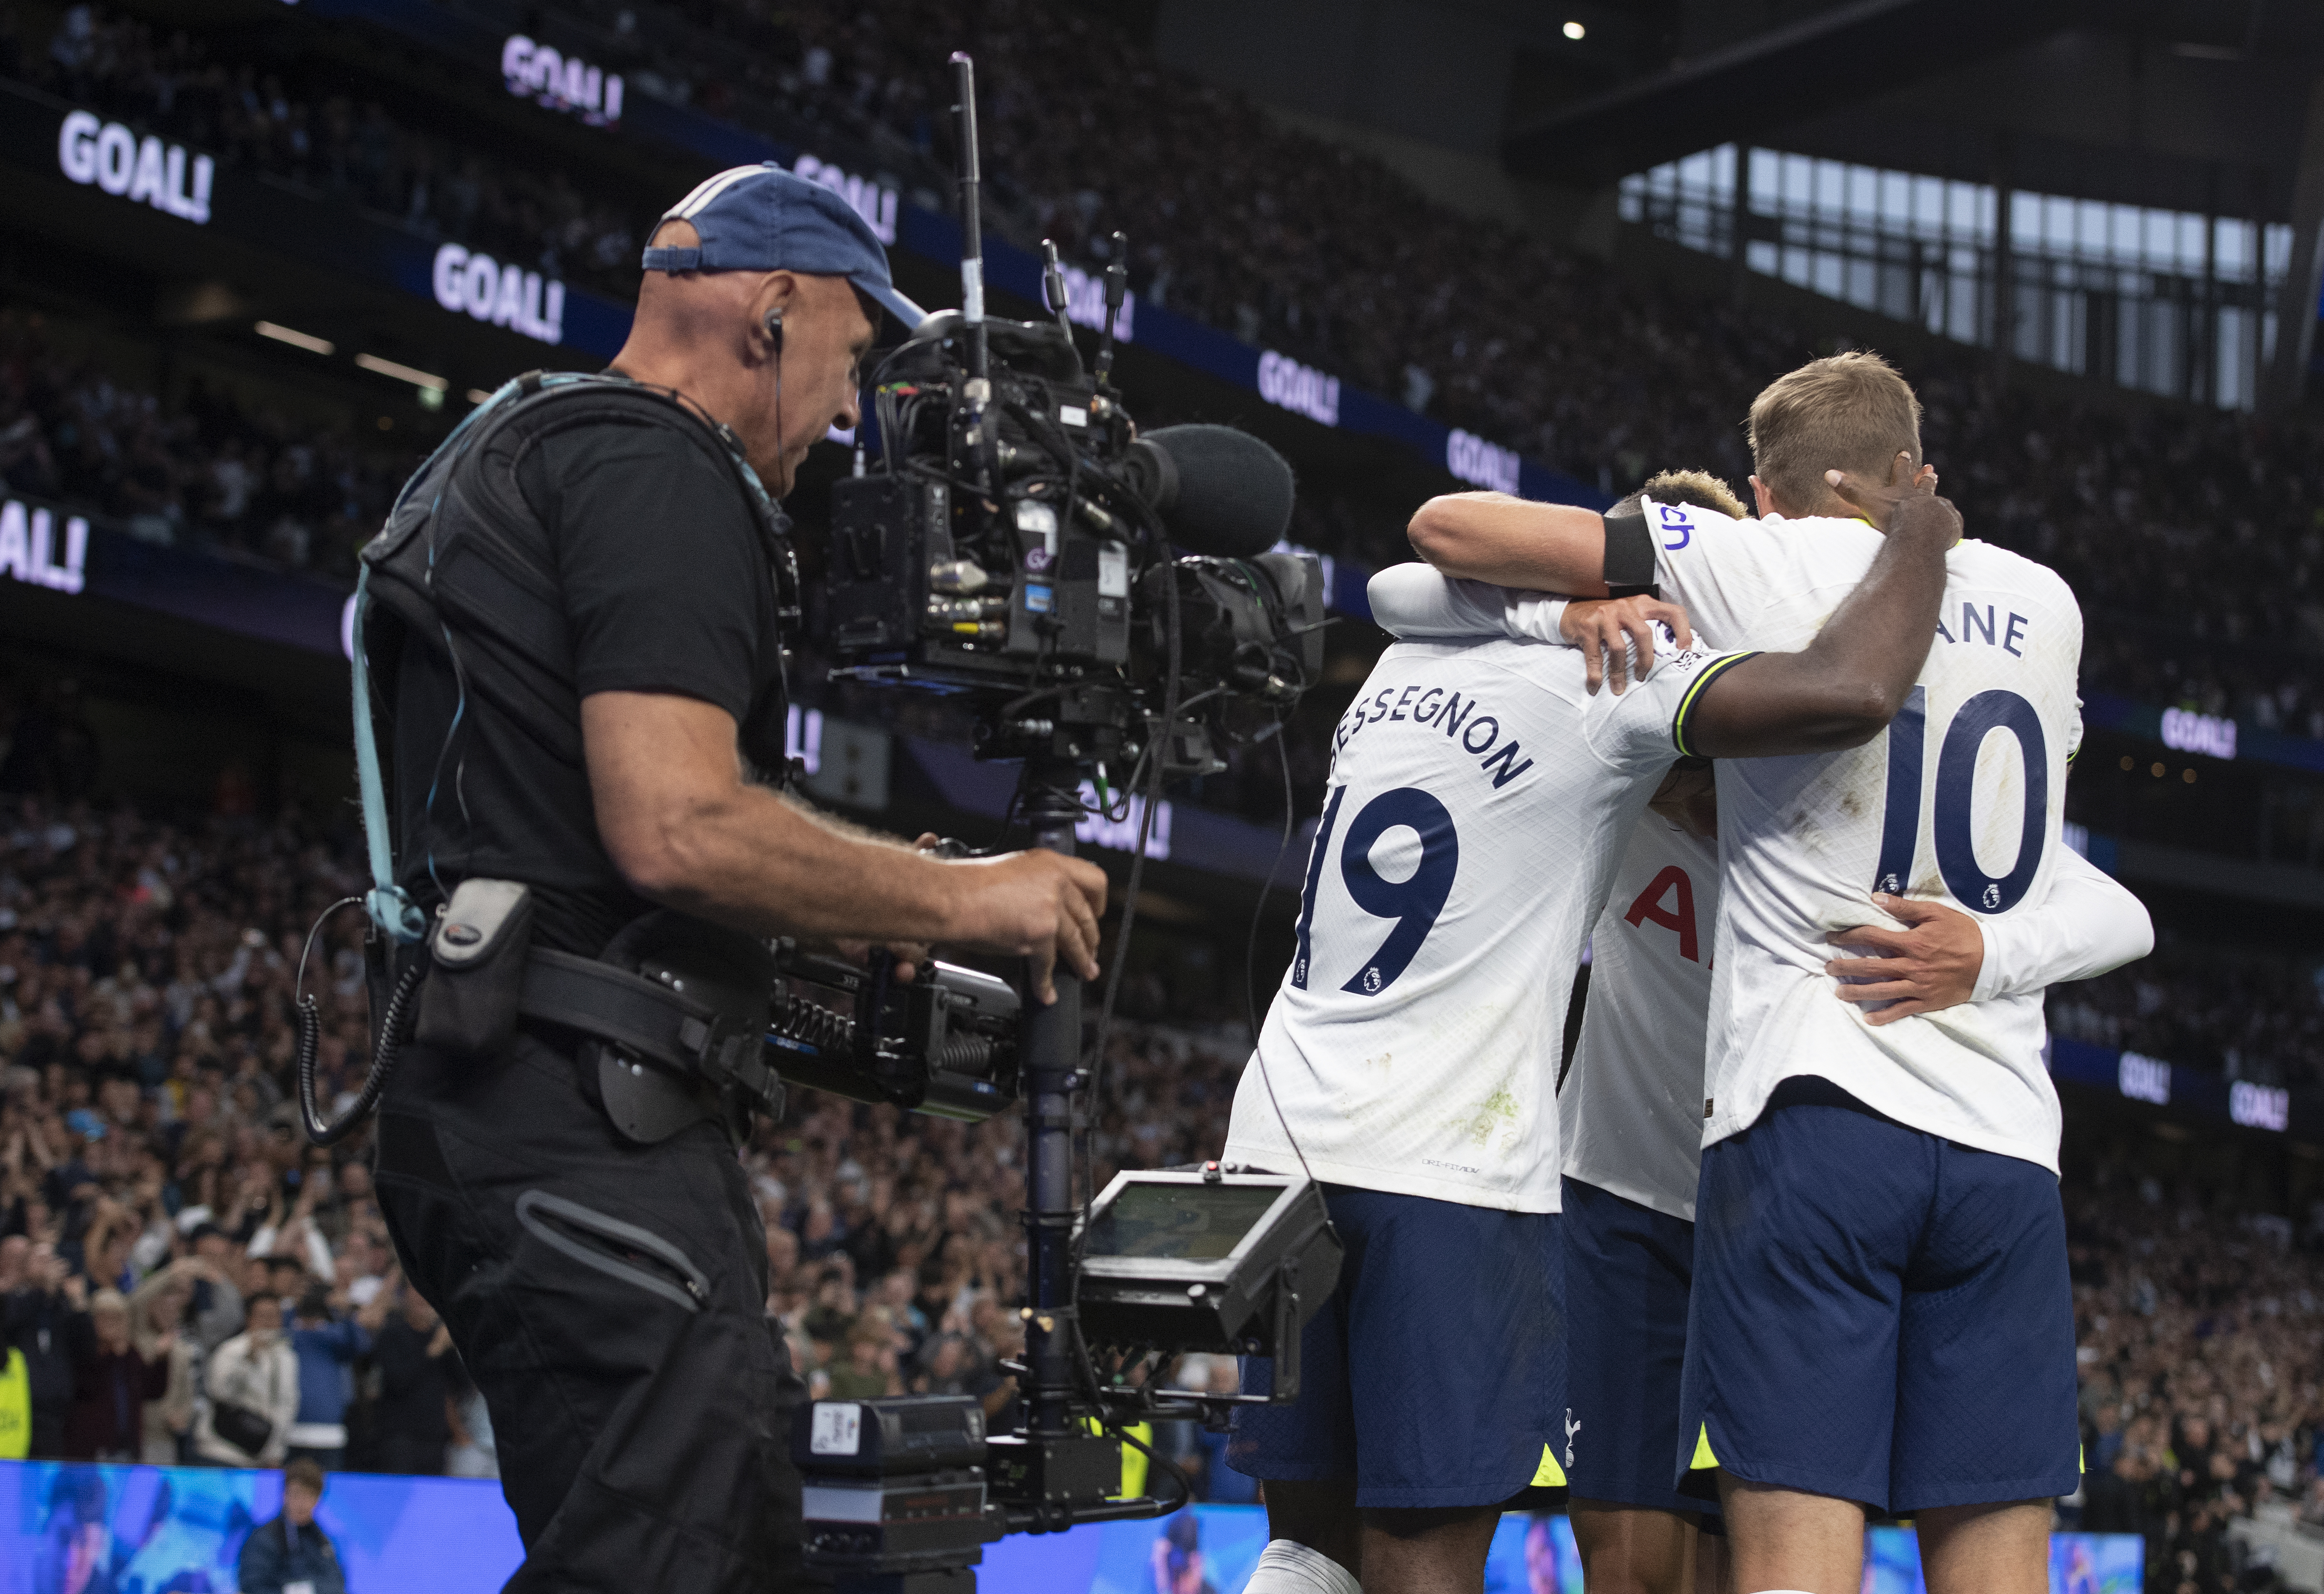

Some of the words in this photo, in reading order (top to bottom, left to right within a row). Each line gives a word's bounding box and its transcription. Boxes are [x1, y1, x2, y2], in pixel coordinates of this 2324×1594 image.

[59, 109, 215, 225] GOAL!
[432, 242, 566, 344] GOAL!
[1258, 350, 1340, 427] GOAL!
[1447, 428, 1520, 497] GOAL!
[0, 499, 90, 595] AL!
[1936, 602, 2028, 658] NE
[2161, 707, 2237, 761] GOAL!
[1873, 684, 2048, 914] 10
[1290, 784, 1458, 997] 19
[2230, 1079, 2289, 1132] GOAL!
